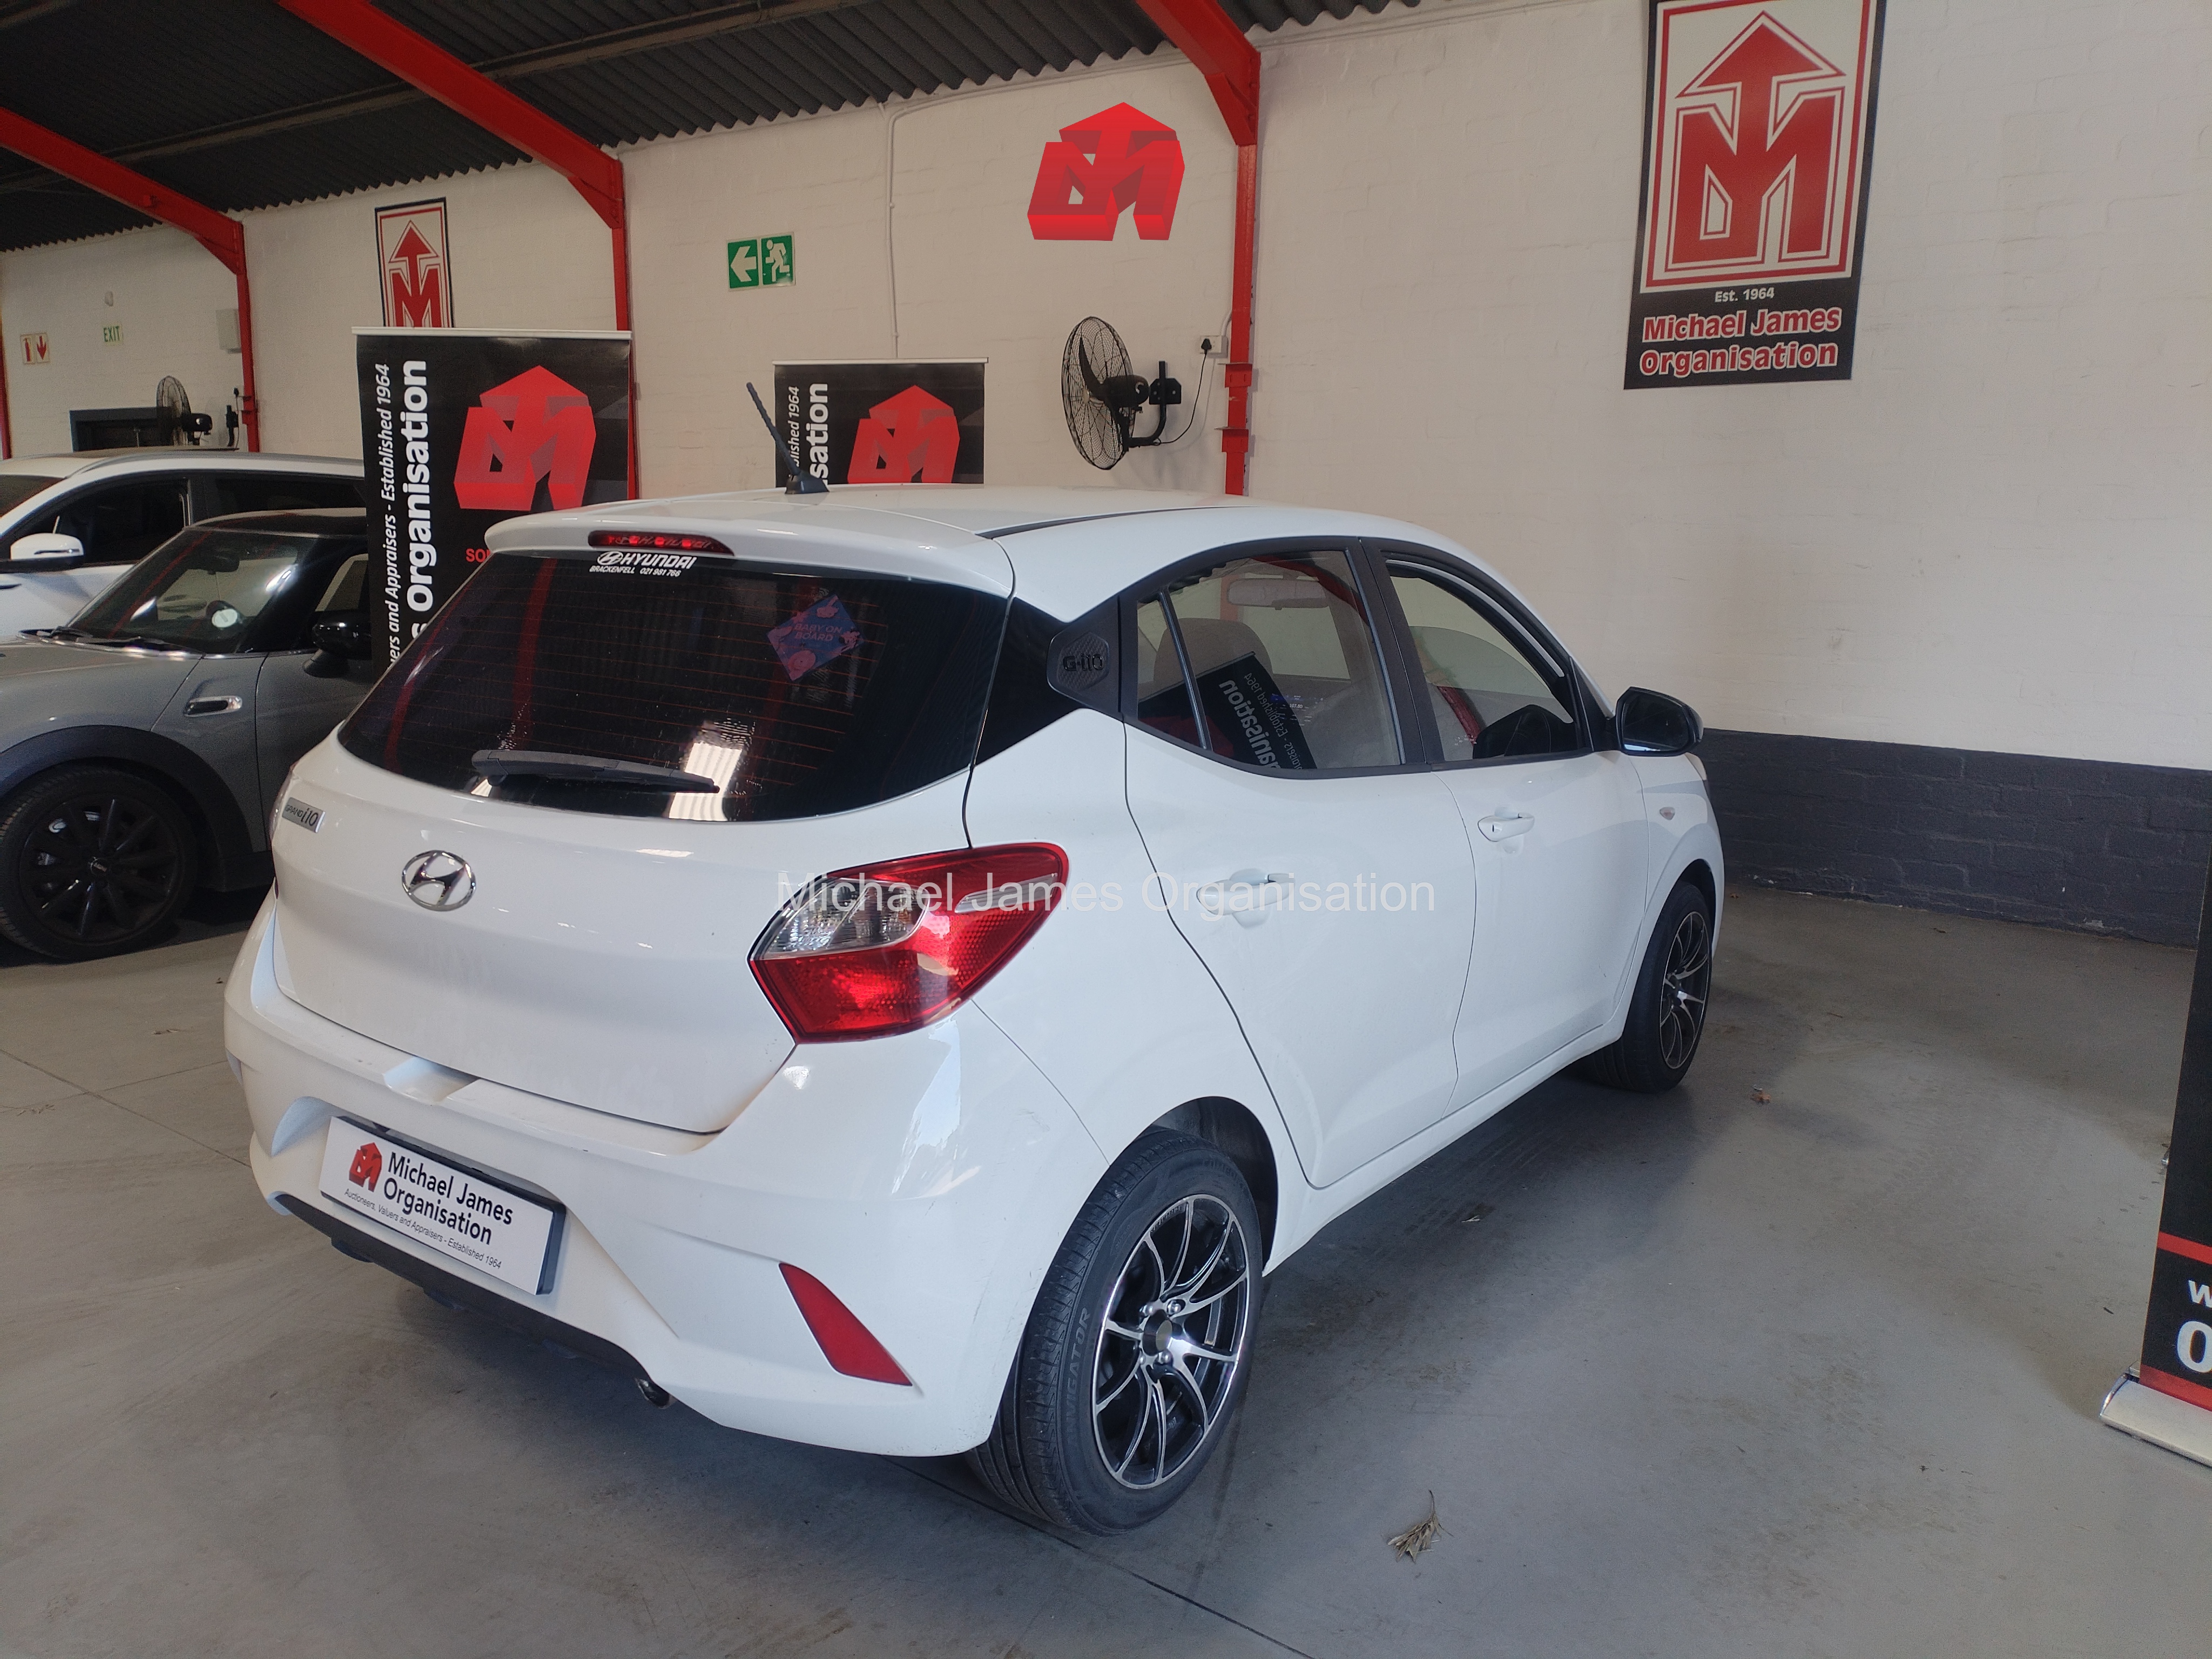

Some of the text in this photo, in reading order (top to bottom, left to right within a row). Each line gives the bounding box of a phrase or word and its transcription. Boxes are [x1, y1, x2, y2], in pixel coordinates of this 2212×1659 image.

[1714, 287, 1775, 303] Est. 1964
[103, 326, 120, 342] EXIT
[1642, 306, 1843, 342] Michael James
[1640, 341, 1838, 378] Organisation
[375, 363, 391, 404] 1964
[788, 386, 800, 417] 1964
[376, 408, 395, 501] Established
[400, 360, 437, 612] Organisation
[382, 514, 401, 599] Appraisers
[589, 565, 636, 574] BRACKENFELL
[620, 553, 697, 569] HYUNDAI
[385, 600, 400, 633] and
[794, 623, 843, 633] BABY ON
[794, 632, 833, 642] BOARD
[301, 807, 319, 827] i10
[388, 1151, 514, 1225] Michael James
[384, 1177, 492, 1245] Organisation
[344, 1188, 376, 1212] Auctioneers,
[379, 1204, 399, 1222] Valuers
[399, 1216, 412, 1227] and
[410, 1221, 443, 1243] Appraisers
[447, 1238, 485, 1262] Established
[485, 1256, 503, 1269] 1964
